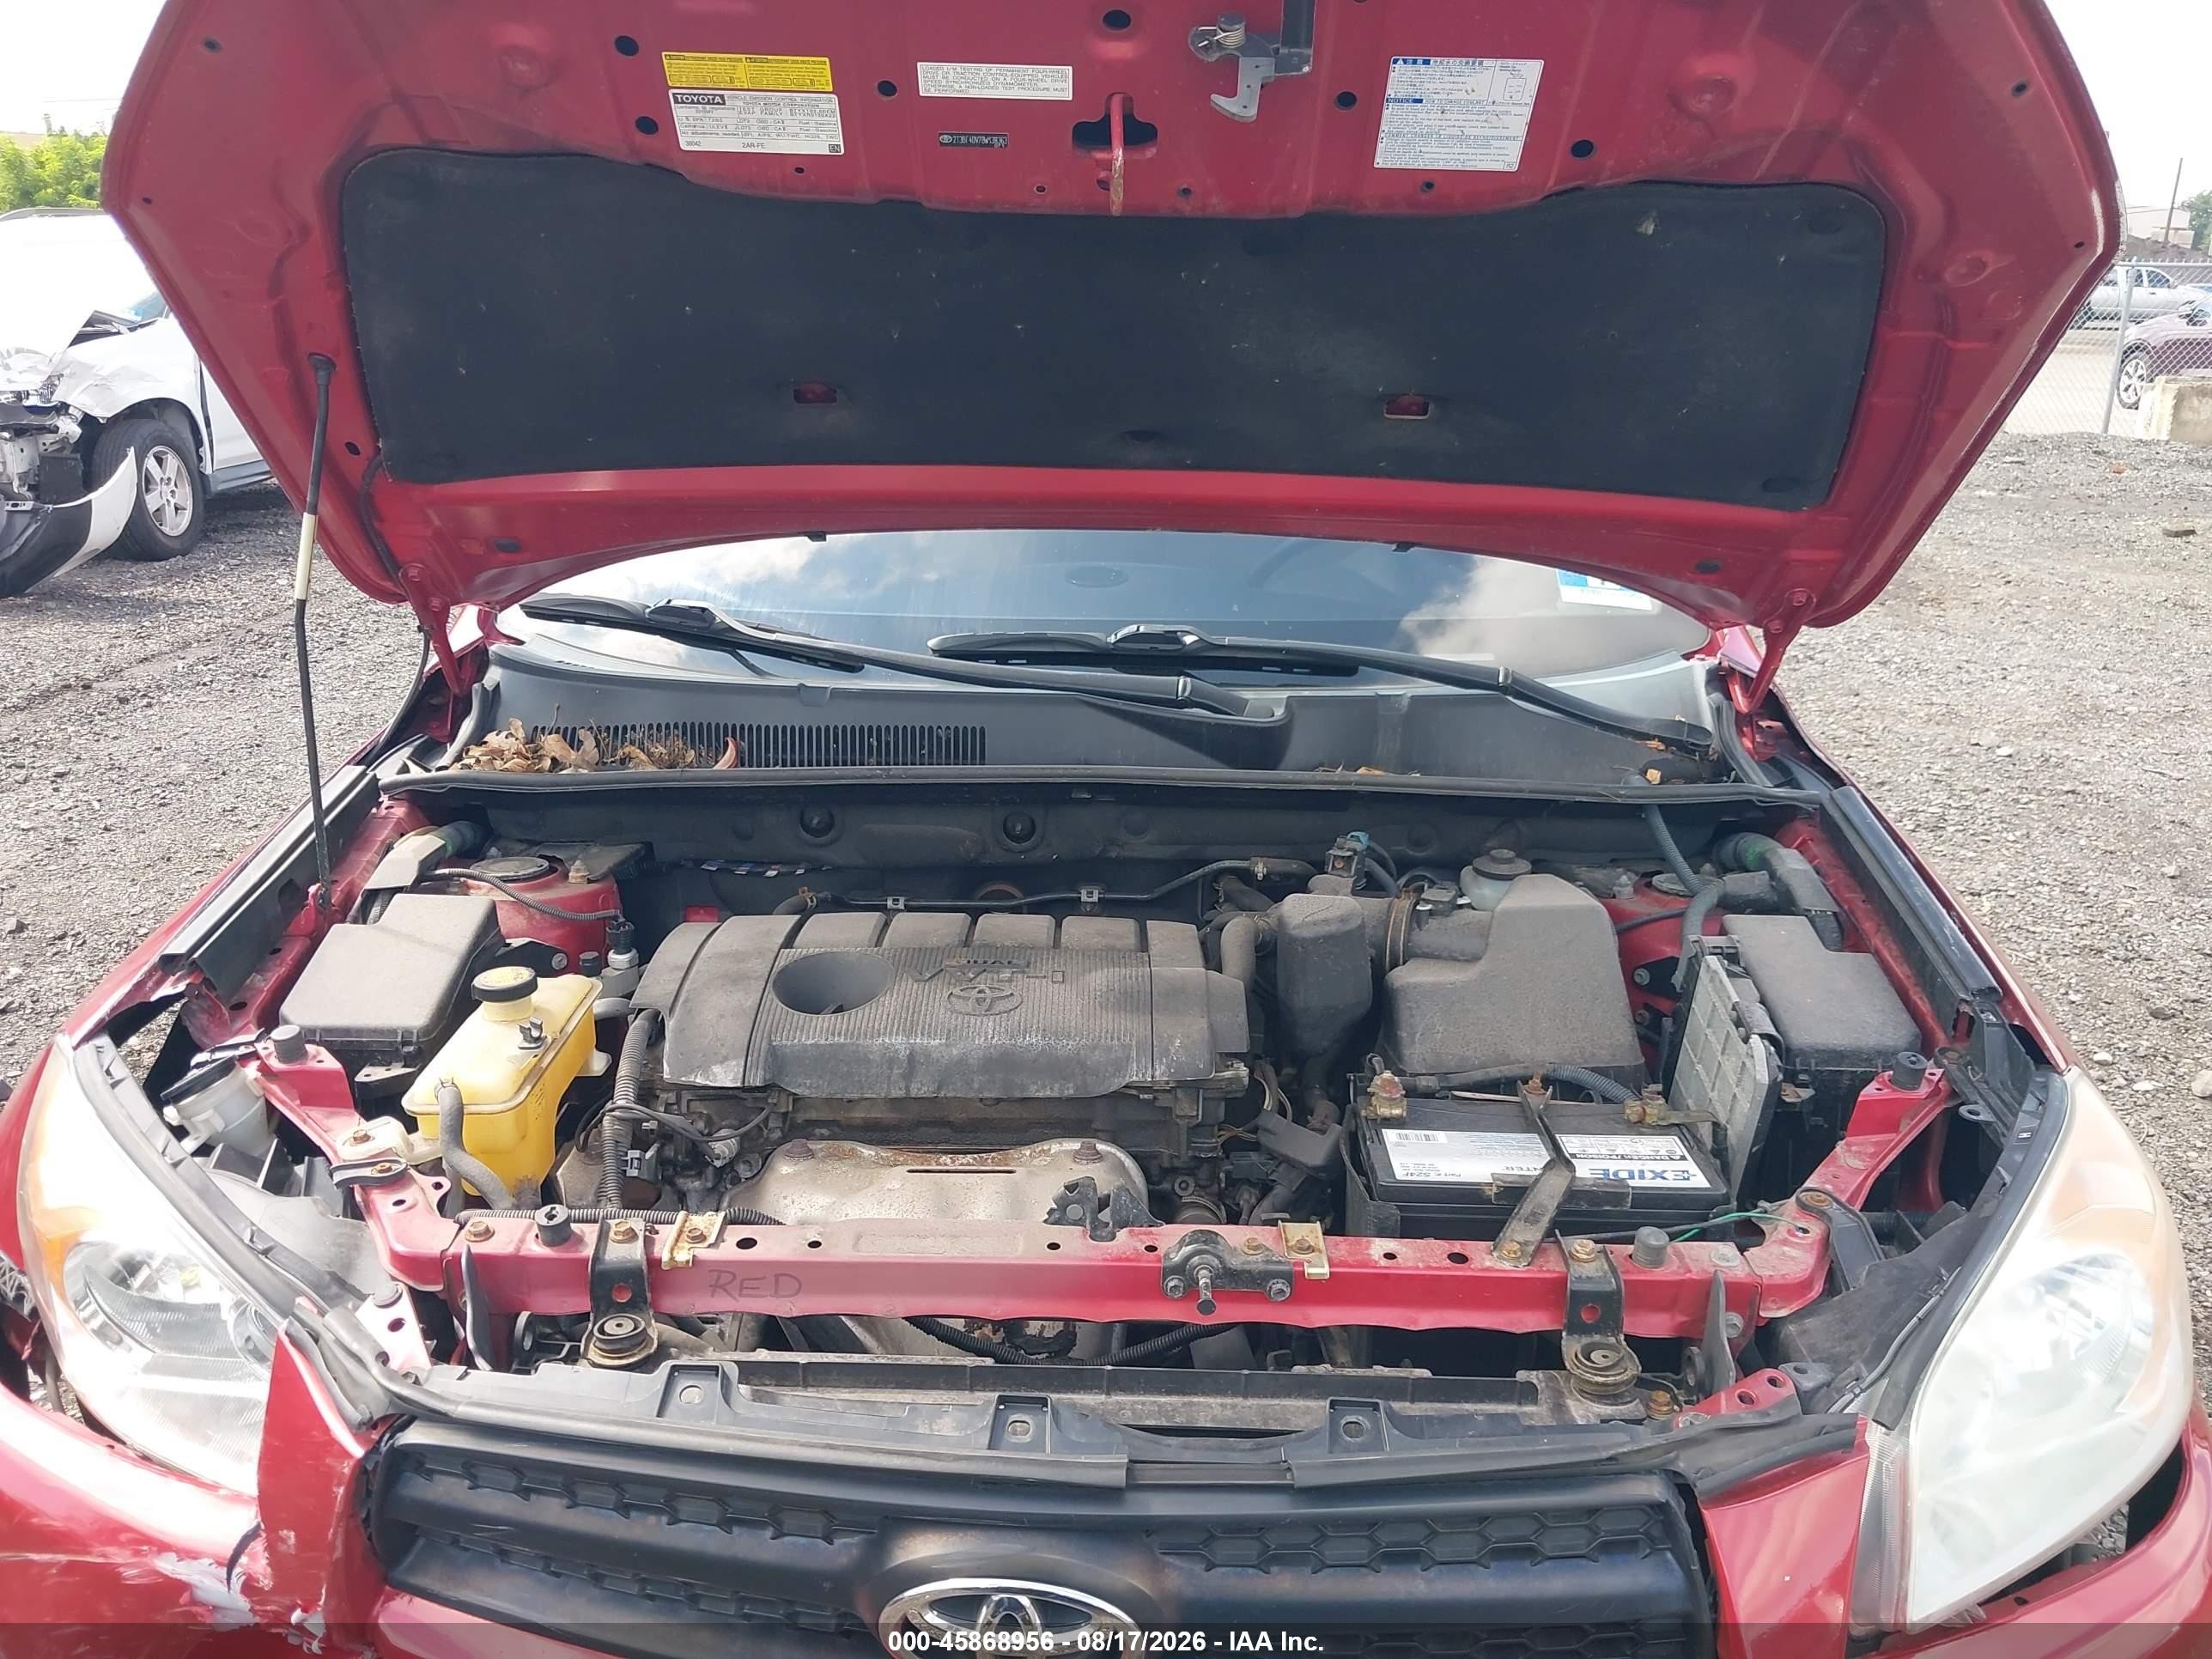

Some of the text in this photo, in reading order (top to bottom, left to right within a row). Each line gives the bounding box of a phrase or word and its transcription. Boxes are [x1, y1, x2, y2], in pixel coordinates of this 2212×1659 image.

[675, 94, 723, 103] TOYOTA
[1589, 1168, 1696, 1181] EXIDE
[708, 1269, 802, 1302] RED
